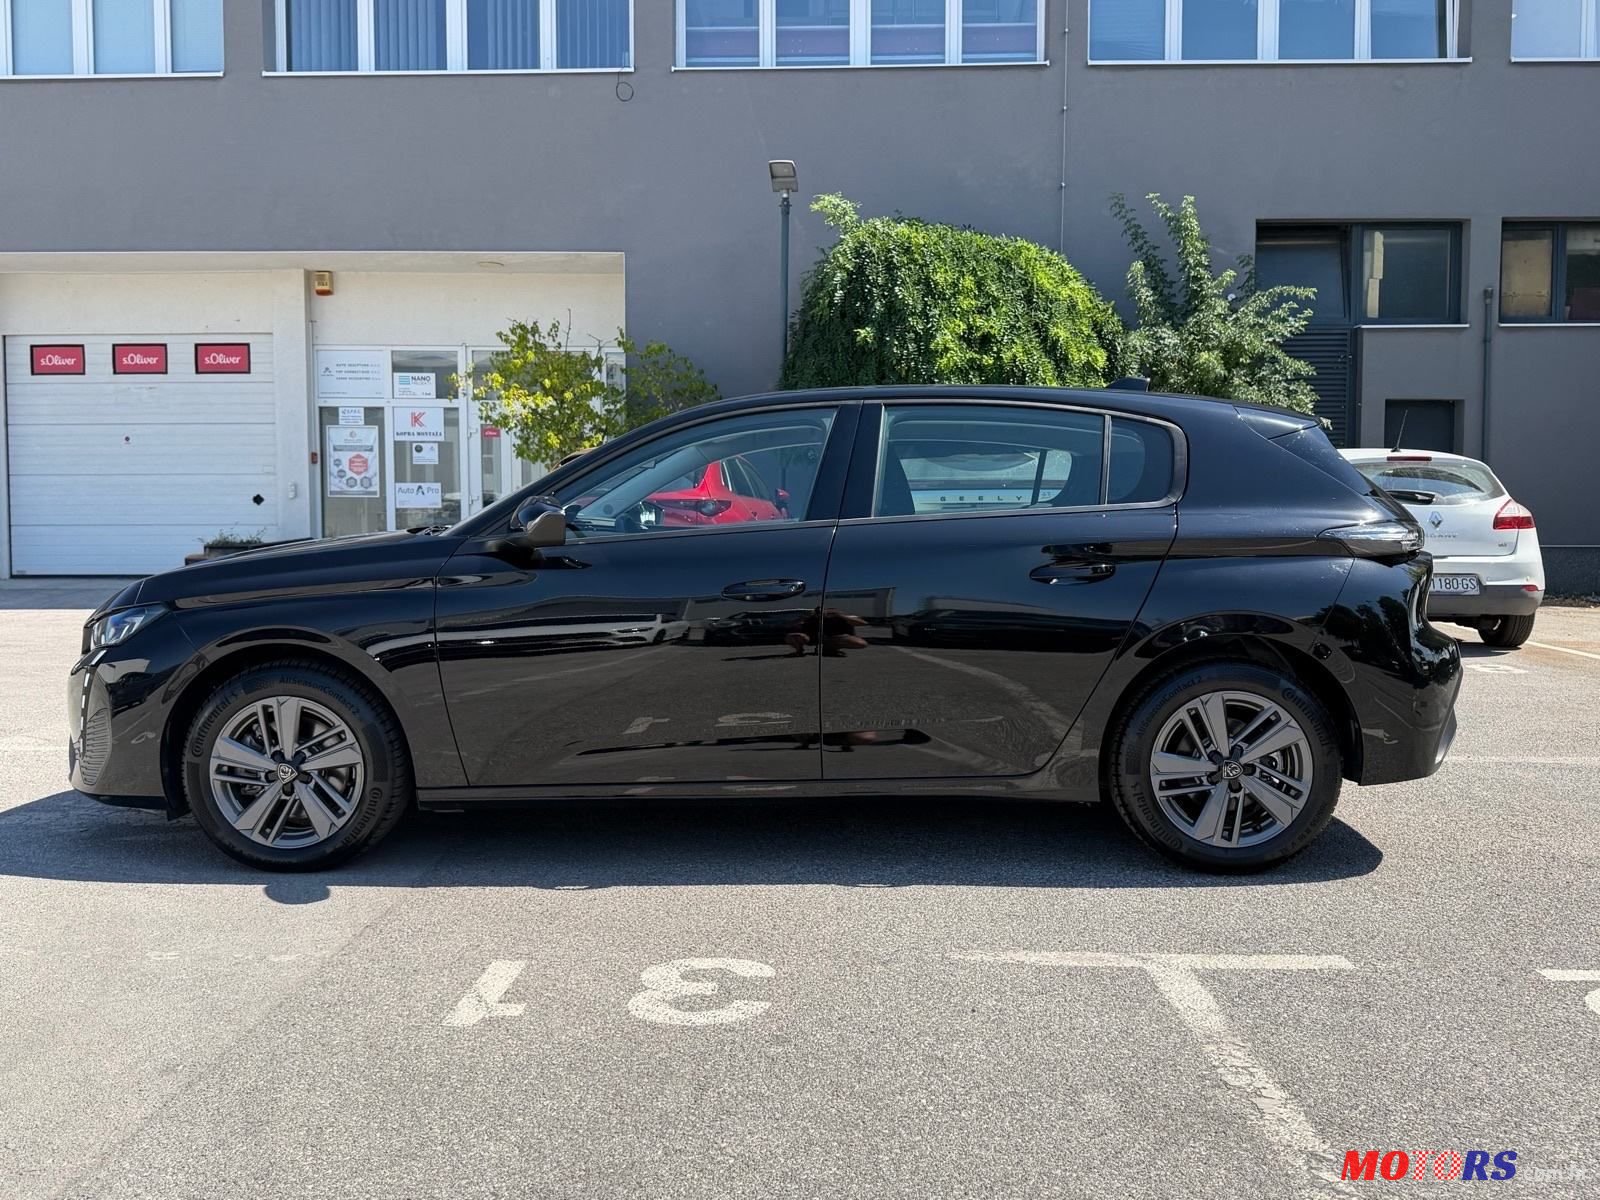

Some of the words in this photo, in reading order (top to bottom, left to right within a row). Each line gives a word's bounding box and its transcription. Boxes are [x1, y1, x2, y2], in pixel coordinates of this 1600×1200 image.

[40, 354, 77, 366] s.Oliver
[122, 353, 159, 365] s.Oliver
[204, 353, 241, 365] s.Oliver
